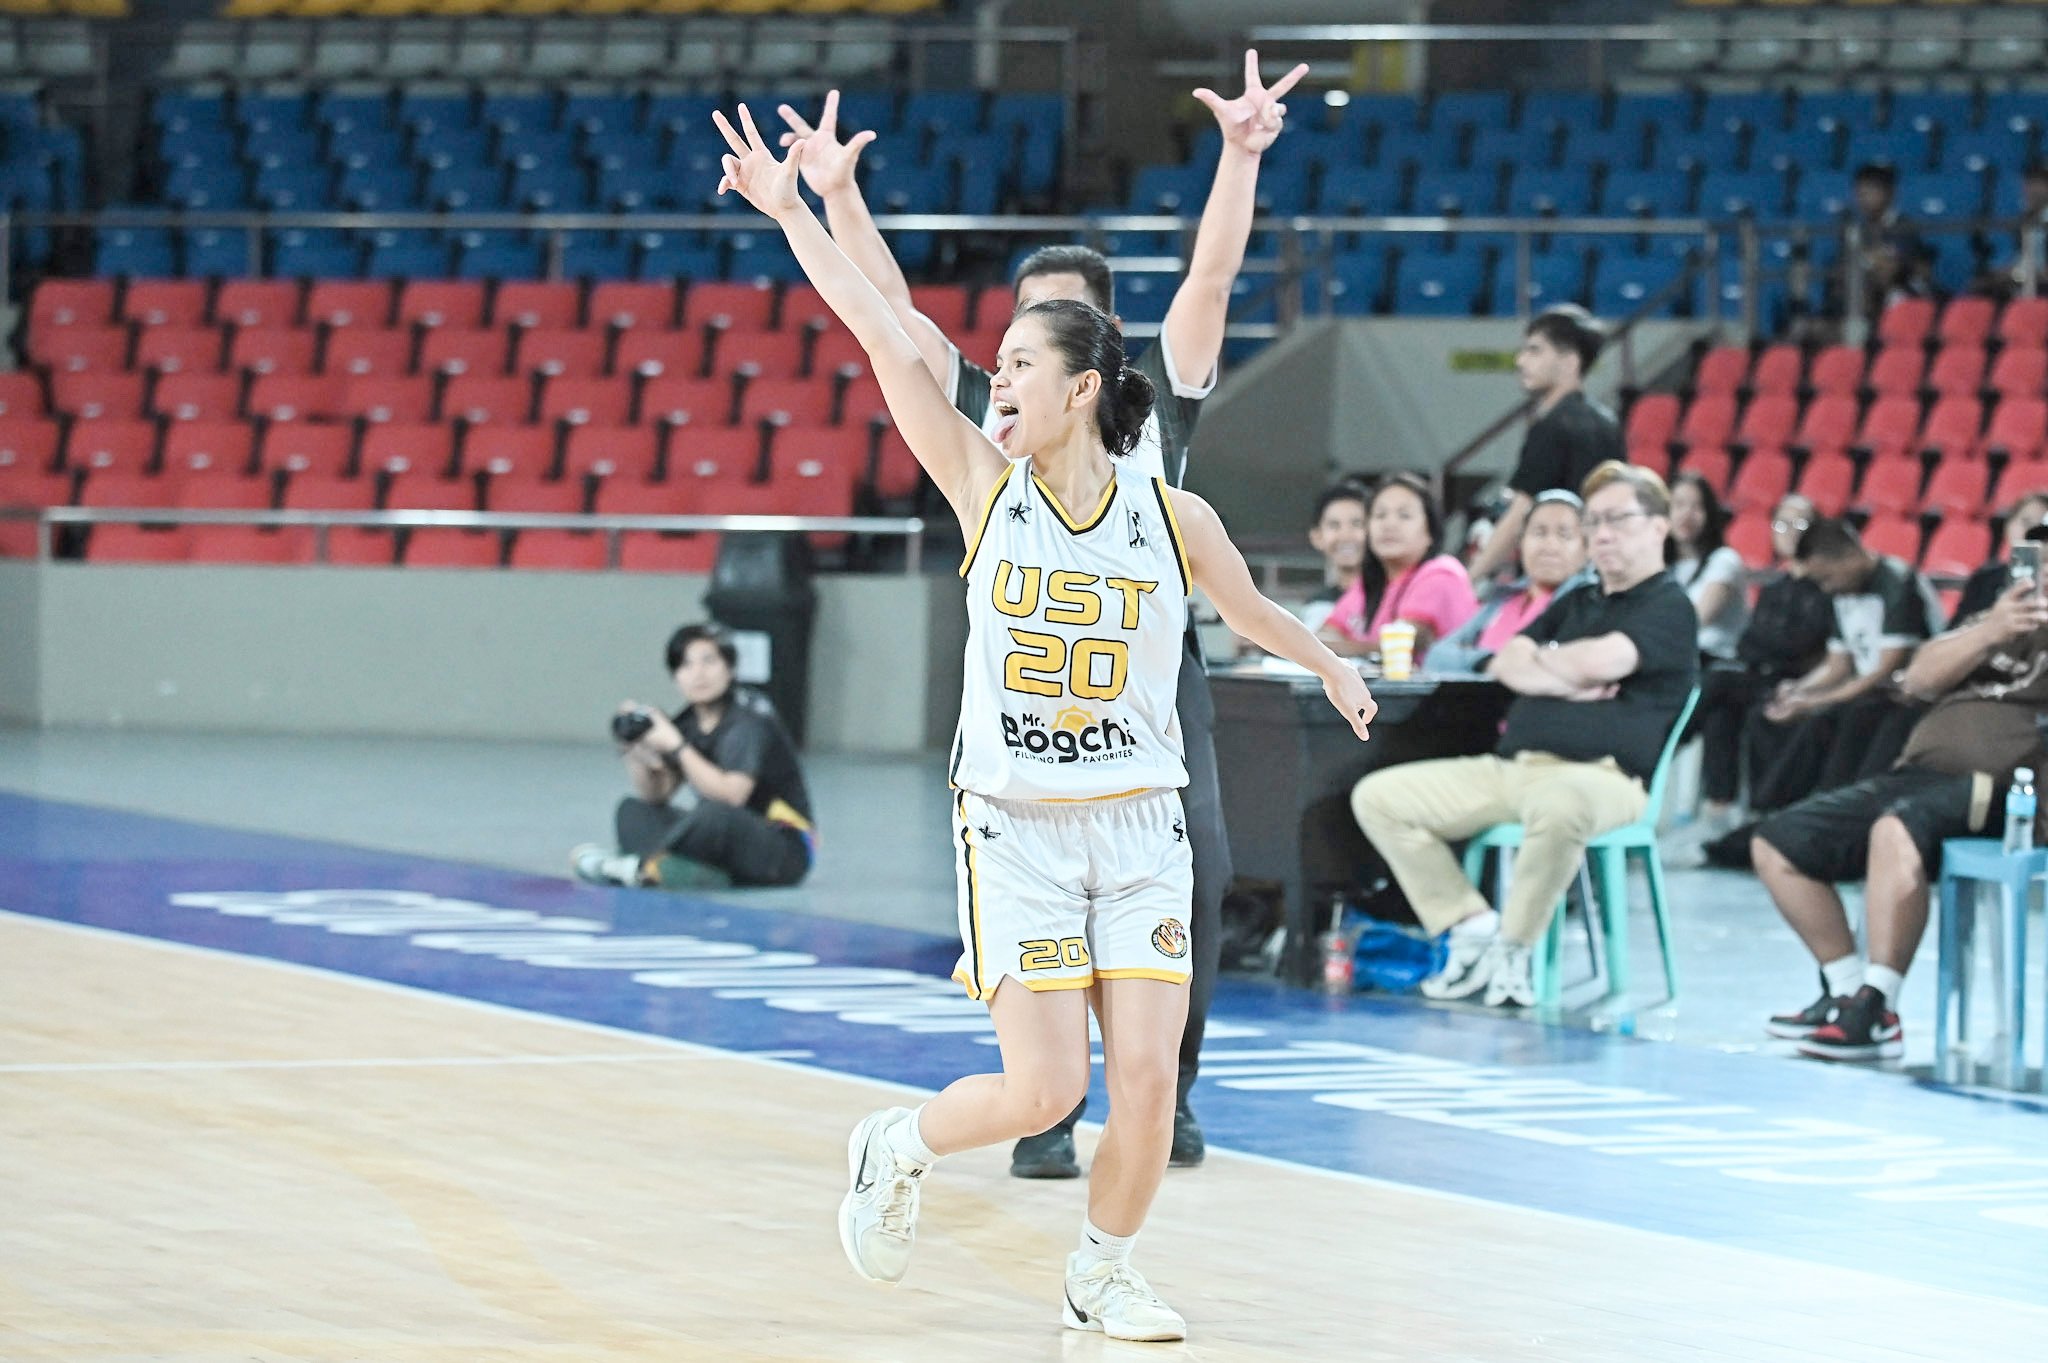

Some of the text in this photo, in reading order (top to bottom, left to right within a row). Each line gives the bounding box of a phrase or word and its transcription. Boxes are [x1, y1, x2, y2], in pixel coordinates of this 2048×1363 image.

[992, 560, 1158, 630] UST
[1004, 627, 1129, 702] 20
[1001, 712, 1136, 763] Bogchi
[1022, 713, 1045, 727] Mr.
[1083, 749, 1133, 763] FAVORITES
[1018, 936, 1089, 971] 20
